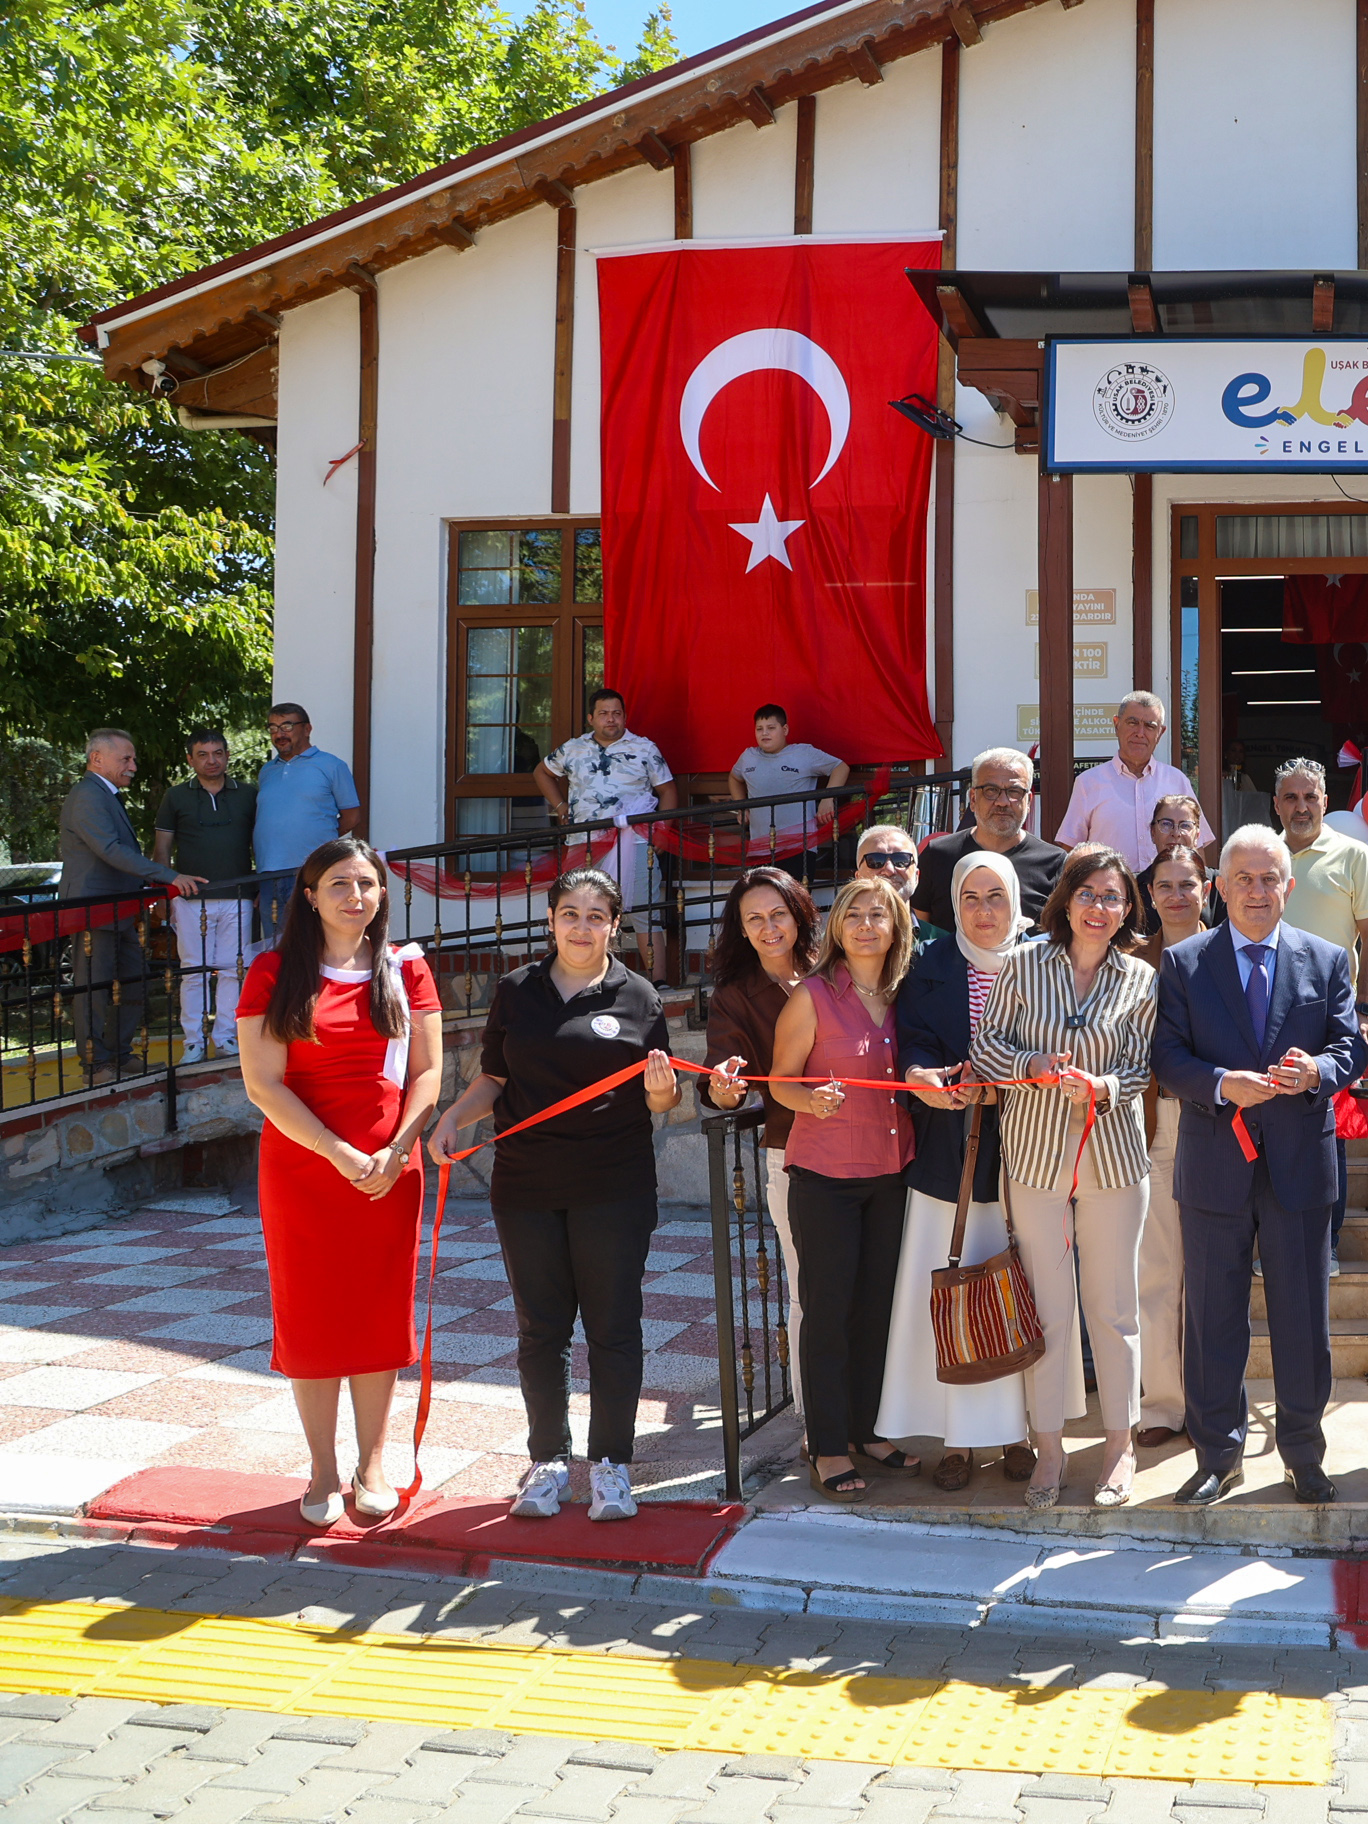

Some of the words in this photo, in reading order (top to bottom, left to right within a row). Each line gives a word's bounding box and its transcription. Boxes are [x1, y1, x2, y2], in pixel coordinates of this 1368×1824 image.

[1330, 360, 1360, 371] UŞAK
[1073, 593, 1095, 601] NDA
[1082, 648, 1102, 657] 100
[1073, 658, 1100, 669] KTİR
[1074, 707, 1104, 716] ÇİNDE
[1081, 717, 1113, 725] ALKOL
